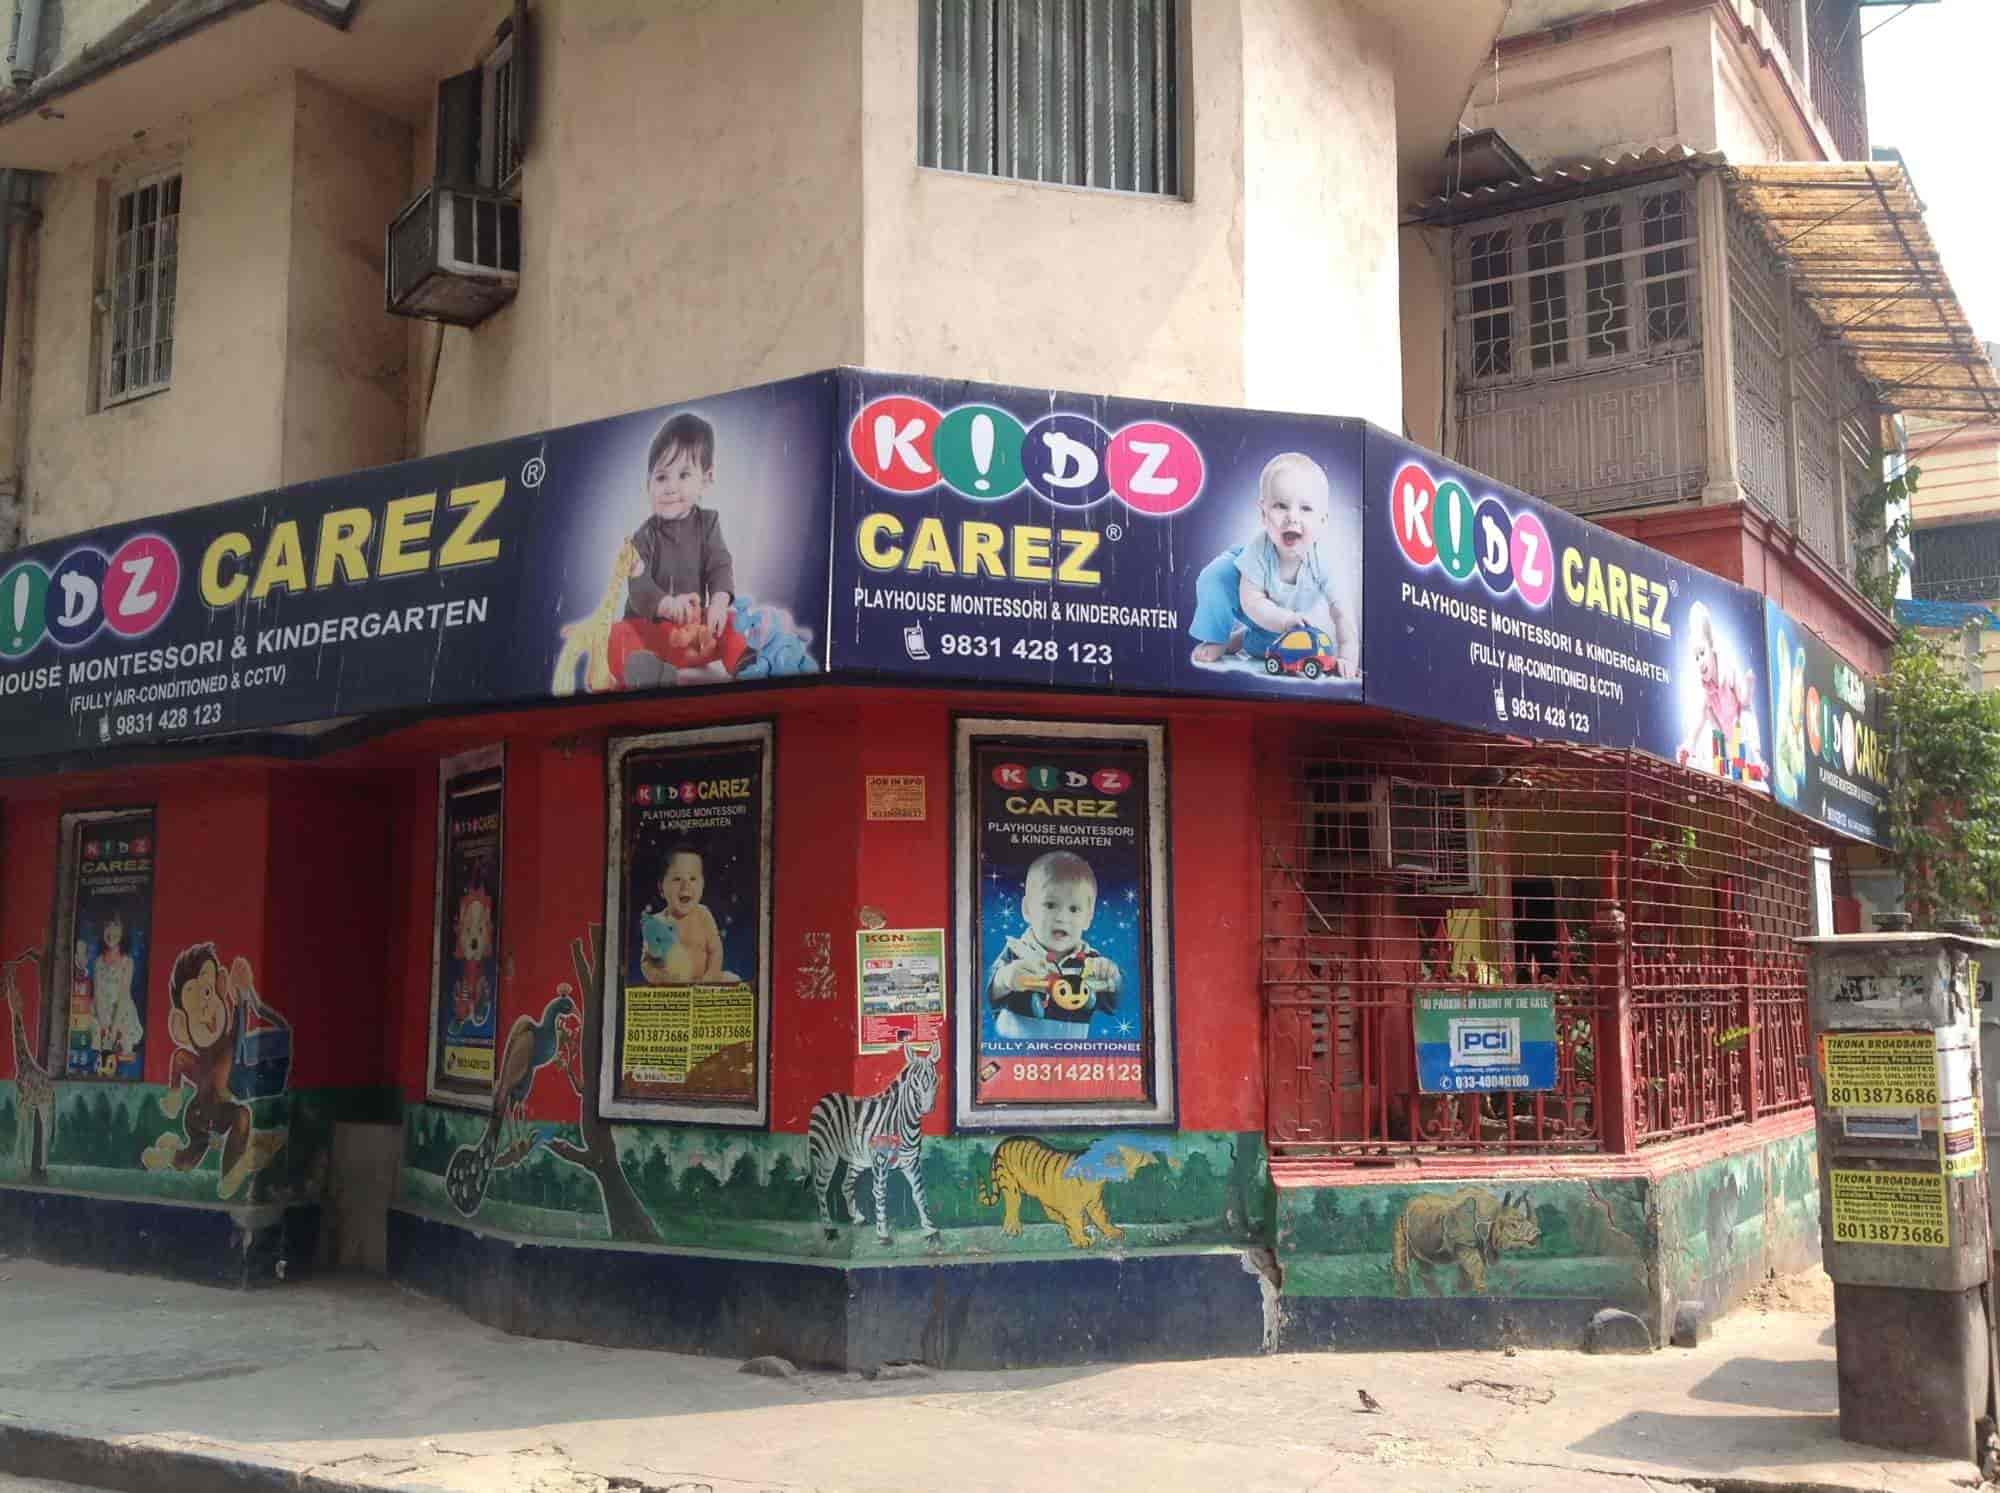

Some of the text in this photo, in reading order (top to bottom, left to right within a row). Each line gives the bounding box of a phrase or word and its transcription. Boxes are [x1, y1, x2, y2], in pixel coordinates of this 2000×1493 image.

[200, 478, 506, 608] CAREZ
[857, 512, 1101, 584] CAREZ
[1561, 546, 1671, 638] CAREZ
[854, 587, 1177, 629] PLAYHOUSE MONTESSORI & KINDERGARTEN
[68, 639, 223, 685] MONTESSORI
[231, 635, 247, 659] &
[256, 597, 489, 655] KINDERGARTEN
[1402, 582, 1671, 685] PLAYHOUSE MONTESSORI & KINDERGARTEN
[940, 633, 1113, 665] 9831 428 123
[1470, 641, 1624, 704] (FULLY AIR-CONDITIONED & CCTV)
[70, 664, 287, 715] (FULLY AIR-CONDITIONED & CCTV)
[116, 703, 222, 736] 9831 428 123
[1511, 697, 1590, 733] 9831 428 123
[698, 777, 751, 800] CAREZ
[694, 805, 747, 817] MONTESSORI
[1005, 796, 1118, 818] CAREZ
[988, 822, 1134, 837] PLAYHOUSE MONTESSORI
[1010, 834, 1112, 847] & KINDERGARTEN
[627, 1029, 689, 1042] 8013873686
[692, 1025, 751, 1039] 8013873686
[1464, 1032, 1506, 1050] PCI
[980, 1042, 1021, 1051] FULLY
[1828, 1039, 1932, 1049] TIKONA BROADBAND
[1013, 1063, 1142, 1081] 9831428123
[1831, 1088, 1937, 1104] 8013873686
[1834, 1173, 1940, 1187] TIKONA BROADBAND
[1837, 1222, 1944, 1244] 8013873686
